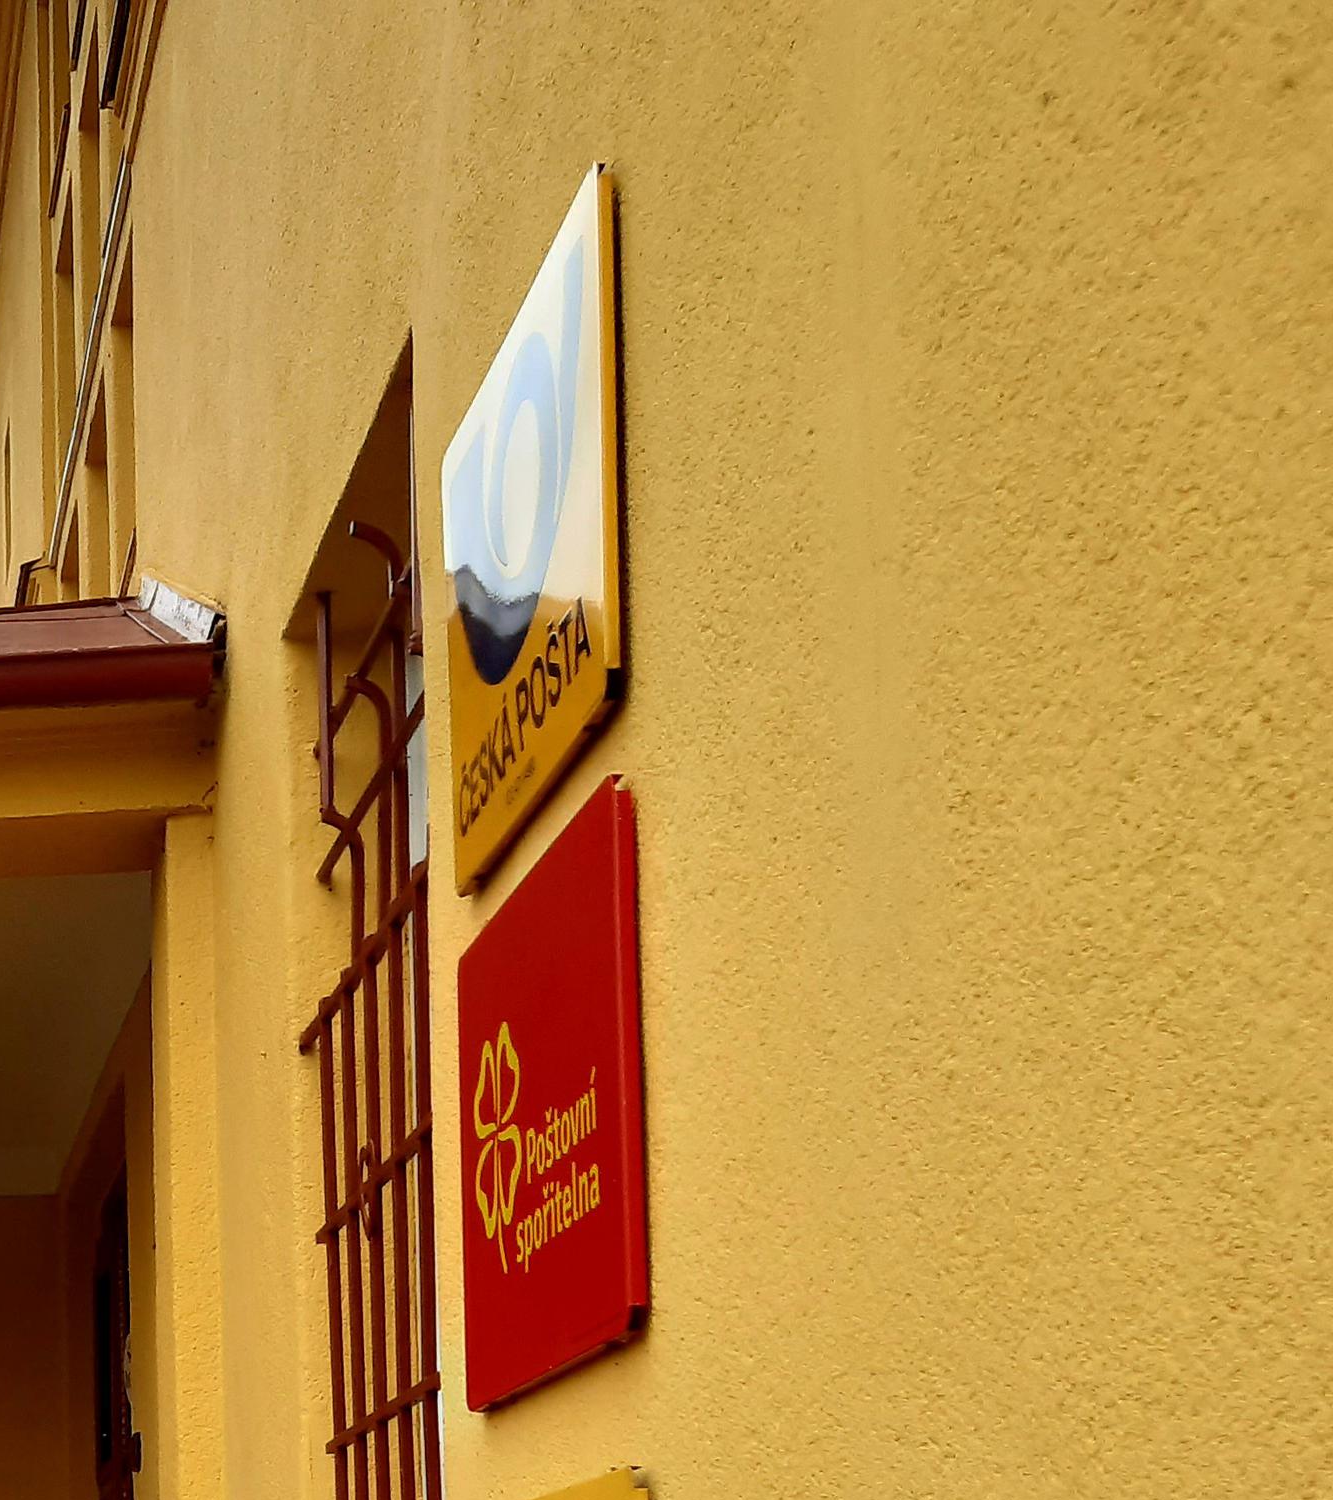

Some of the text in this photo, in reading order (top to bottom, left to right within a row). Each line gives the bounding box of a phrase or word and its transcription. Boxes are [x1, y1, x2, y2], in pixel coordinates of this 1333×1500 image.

[459, 692, 517, 837] ČESKÁ
[515, 596, 592, 752] POŠTA
[526, 1066, 597, 1184] Poštovní
[516, 1162, 600, 1273] spořitelna
